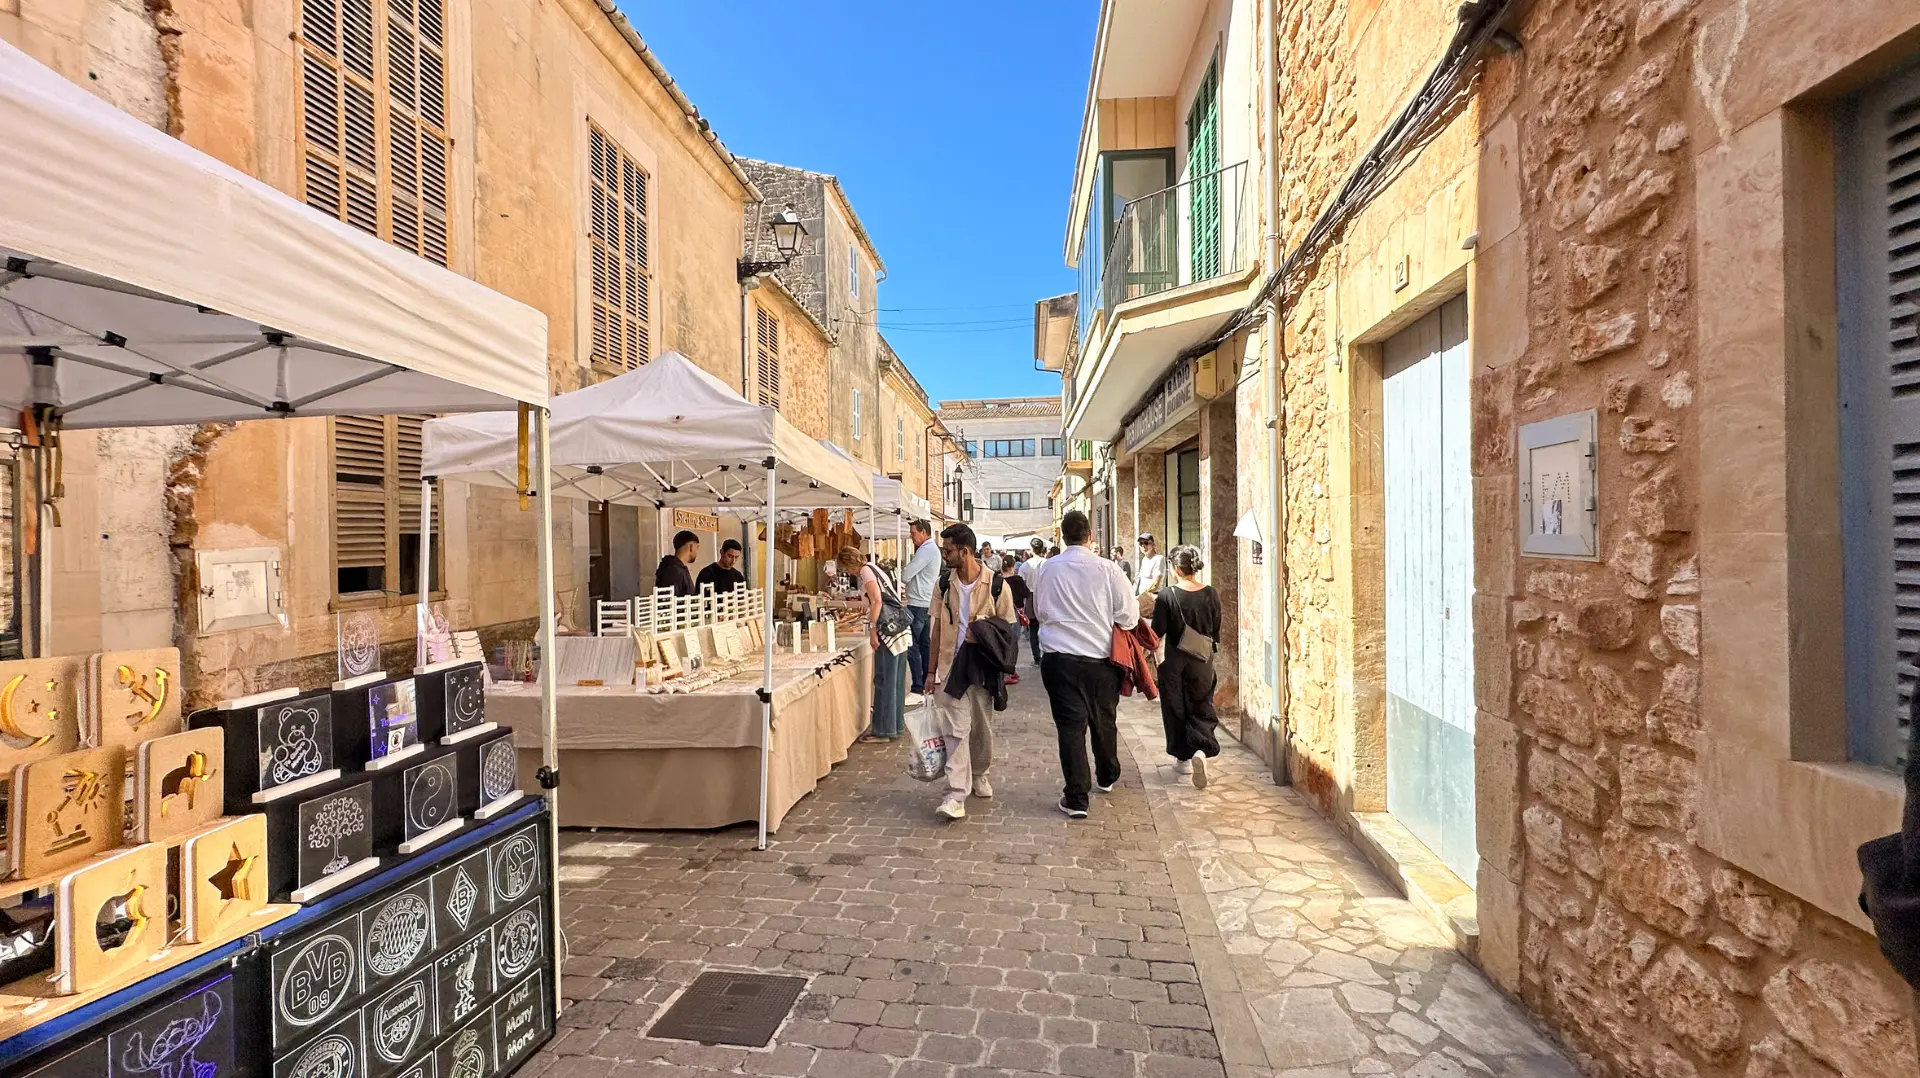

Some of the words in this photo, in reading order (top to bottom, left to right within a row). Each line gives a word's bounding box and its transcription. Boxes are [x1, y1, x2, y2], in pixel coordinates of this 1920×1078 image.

[1395, 261, 1404, 285] 12
[1167, 363, 1190, 397] RADIO
[291, 943, 347, 1010] BVB
[308, 990, 330, 1015] 09
[508, 983, 529, 1010] And
[505, 1004, 533, 1038] Many
[506, 1028, 535, 1060] More
